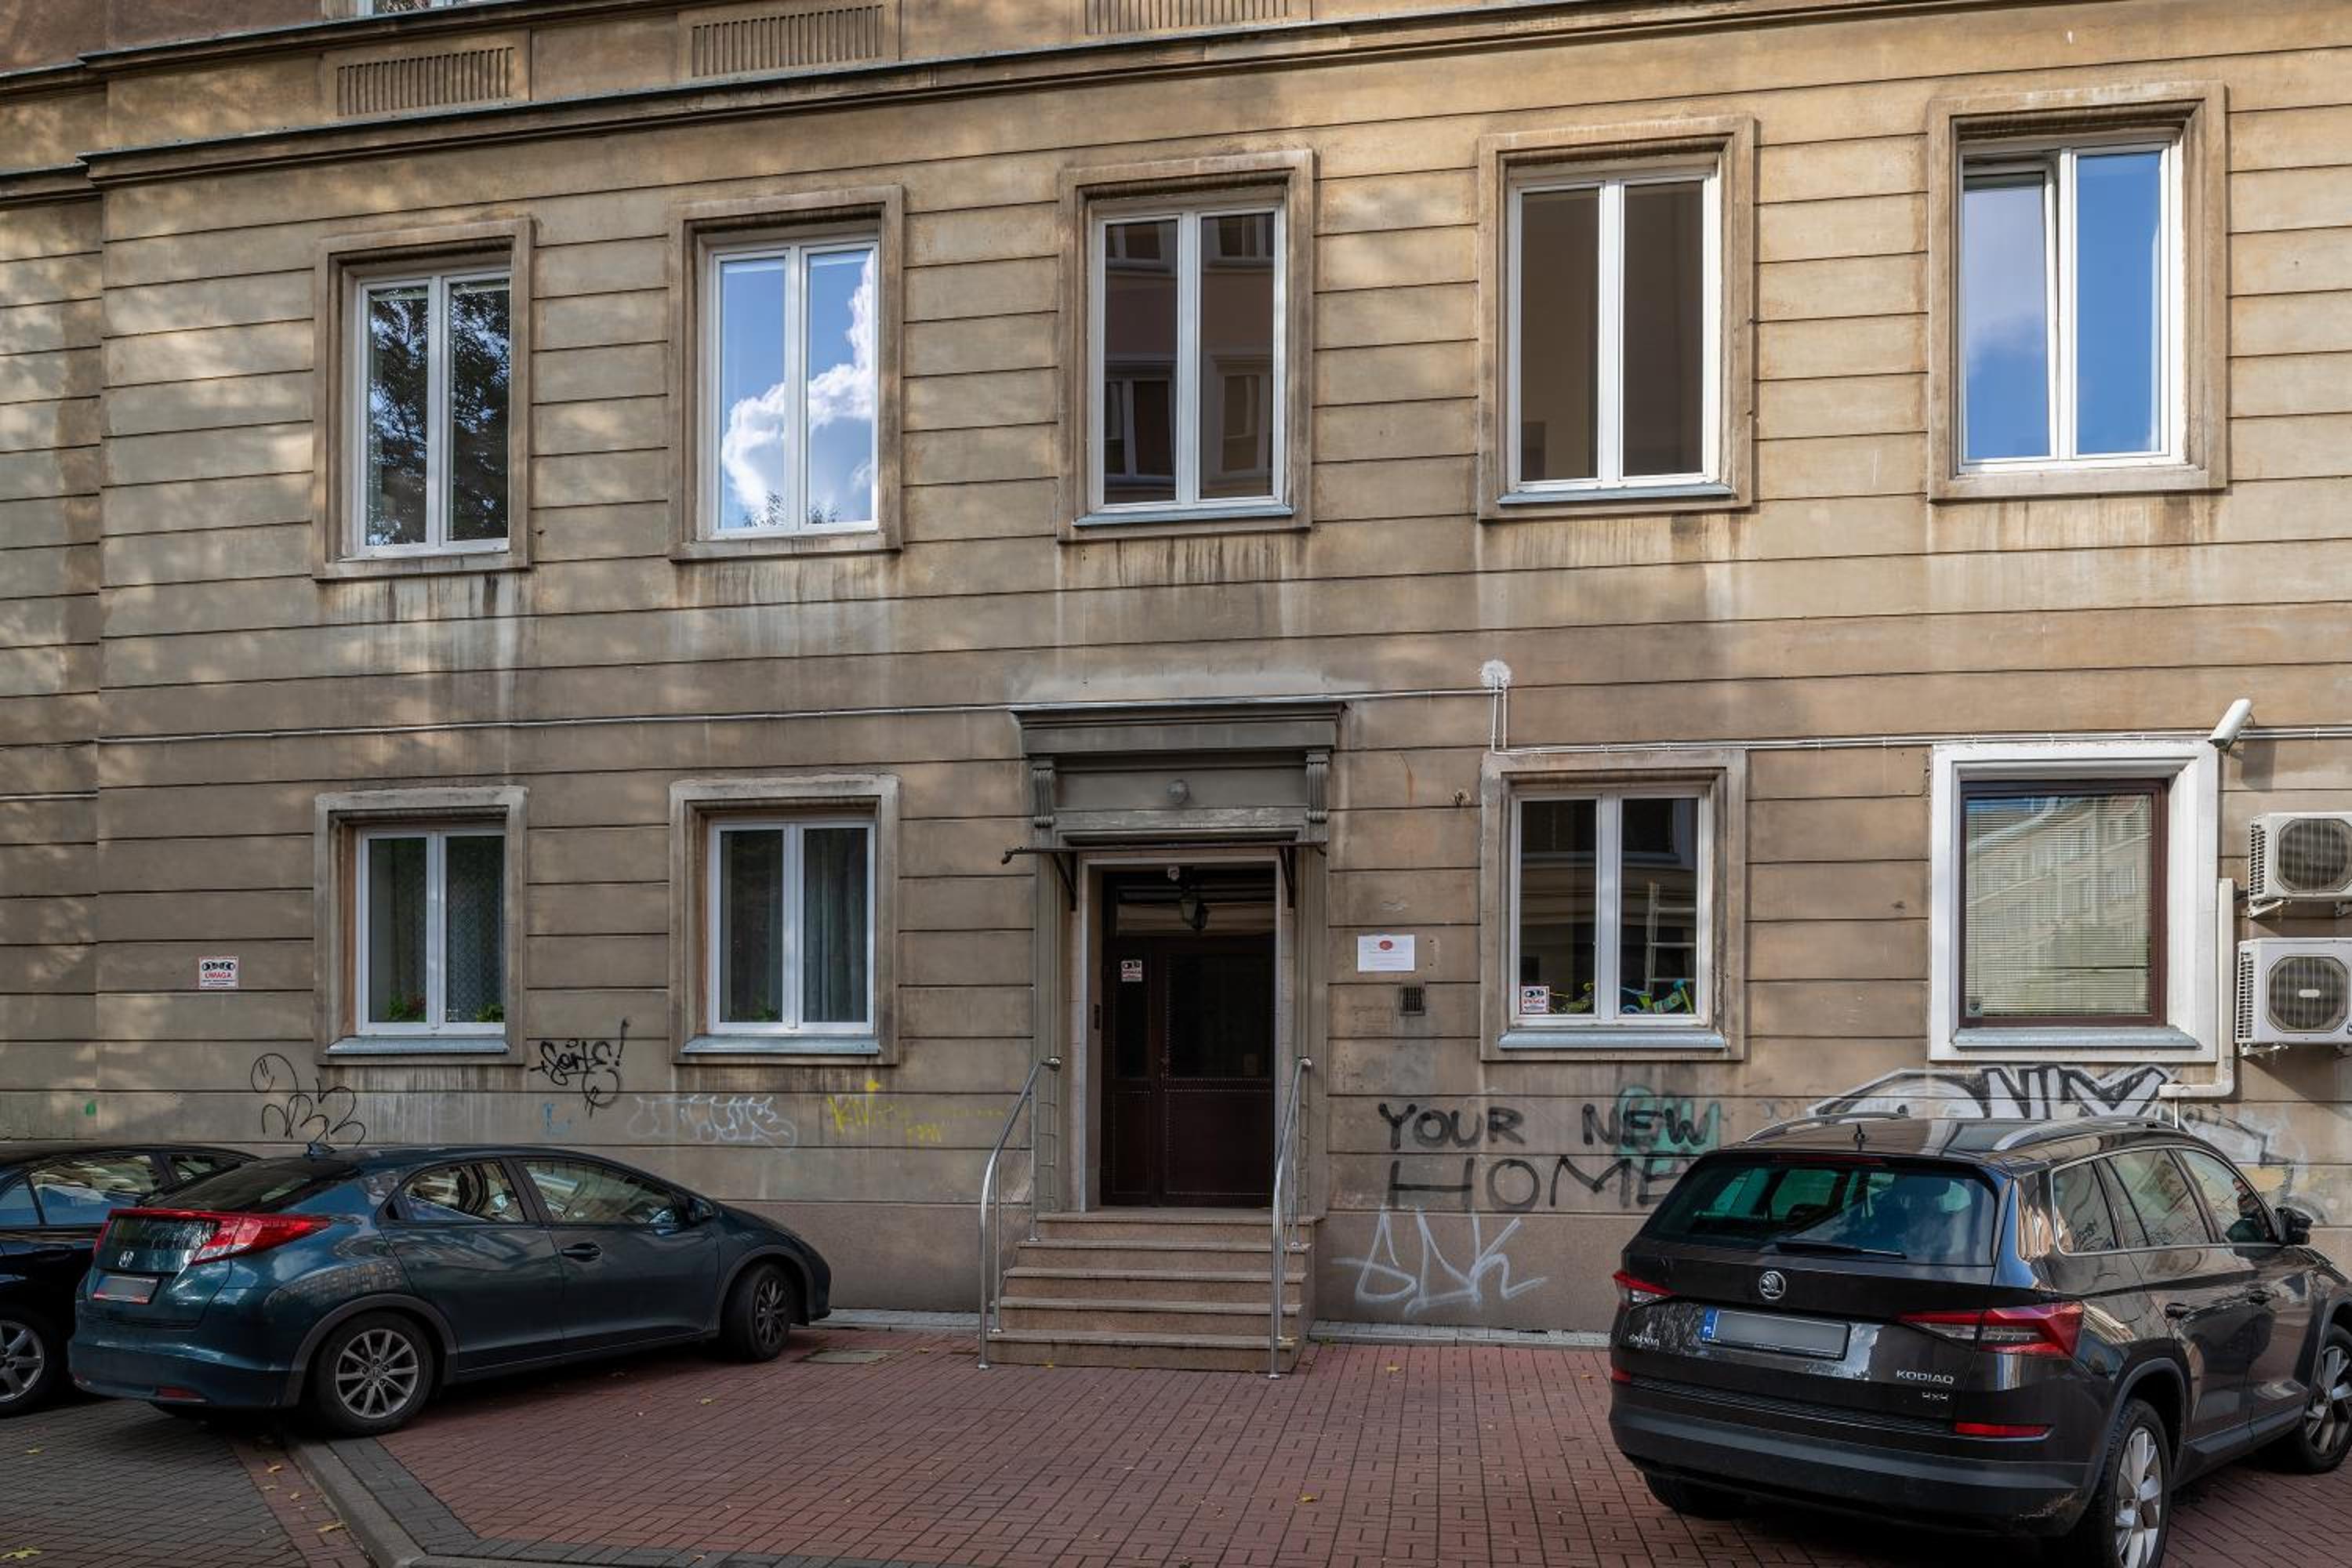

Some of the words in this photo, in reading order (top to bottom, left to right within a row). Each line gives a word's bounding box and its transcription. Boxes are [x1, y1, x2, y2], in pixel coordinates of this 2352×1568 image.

[1377, 1102, 1526, 1150] YOUR
[1582, 1102, 1710, 1148] NEW
[1386, 1151, 1686, 1212] HOME
[1896, 1369, 1955, 1385] KODIAQ
